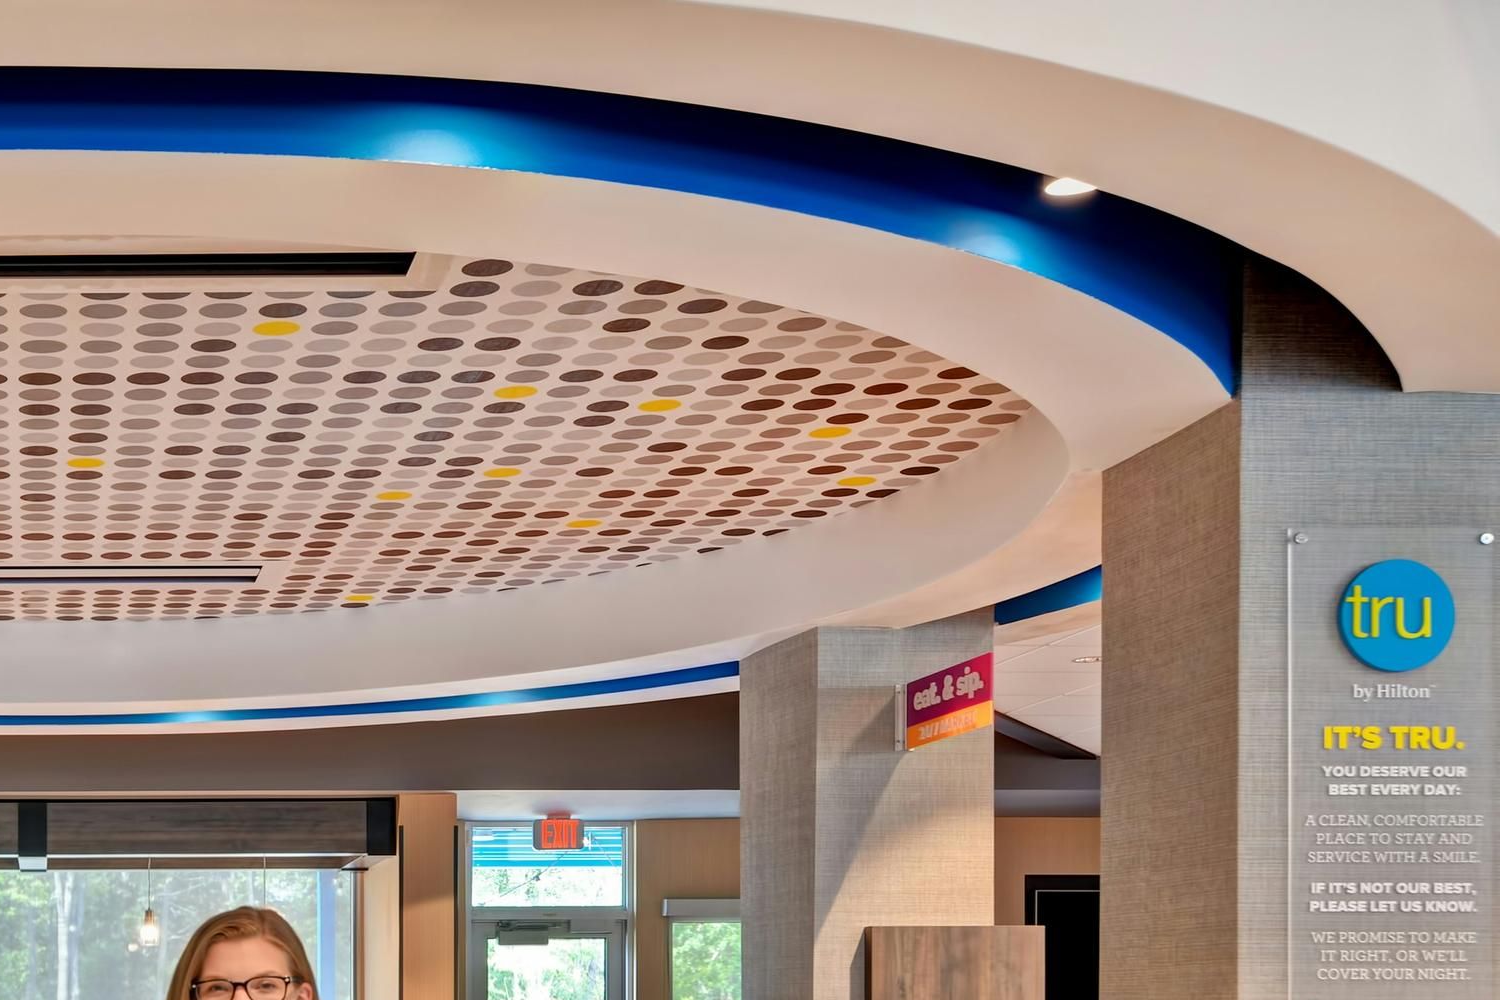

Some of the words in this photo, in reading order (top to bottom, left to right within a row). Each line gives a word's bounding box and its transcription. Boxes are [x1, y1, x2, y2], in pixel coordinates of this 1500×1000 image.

[1345, 585, 1432, 639] tru
[913, 682, 941, 710] eat.
[942, 674, 955, 701] &
[956, 666, 984, 699] sip.
[1353, 684, 1373, 702] by
[1323, 725, 1382, 750] IT'S
[1388, 725, 1466, 750] TRU.
[1322, 766, 1356, 777] YOU
[1360, 766, 1429, 777] DESERVE
[1432, 766, 1468, 777] OUR
[1328, 784, 1367, 796] BEST
[1370, 784, 1422, 796] EVERY
[1424, 784, 1462, 796] DAY:
[1305, 815, 1316, 826] A
[1318, 815, 1371, 828] CLEAN,
[1373, 815, 1484, 826] COMFORTABLE
[542, 820, 578, 848] EXIT
[1315, 833, 1365, 845] PLACE
[1368, 833, 1391, 845] TO
[1394, 833, 1435, 845] STAY
[1437, 833, 1473, 845] AND
[1307, 851, 1371, 863] SERVICE
[1374, 851, 1415, 863] WITH
[1418, 851, 1431, 863] A
[1433, 851, 1481, 863] SMILE.
[1311, 882, 1327, 894] IF
[1329, 882, 1357, 894] IT'S
[1360, 882, 1393, 894] NOT
[1396, 882, 1430, 894] OUR
[1433, 882, 1477, 896] BEST,
[1309, 901, 1367, 912] PLEASE
[1370, 901, 1396, 912] LET
[1401, 901, 1423, 912] US
[1425, 901, 1478, 912] KNOW.
[1311, 932, 1336, 944] WE
[1339, 932, 1405, 944] PROMISE
[1408, 932, 1430, 944] TO
[1433, 932, 1477, 944] MAKE
[1321, 950, 1336, 962] IT
[1339, 950, 1393, 963] RIGHT,
[1396, 950, 1419, 962] OR
[1422, 950, 1468, 962] WE'LL
[1316, 968, 1370, 980] COVER
[1372, 968, 1415, 980] YOUR
[1417, 968, 1472, 980] NIGHT.
